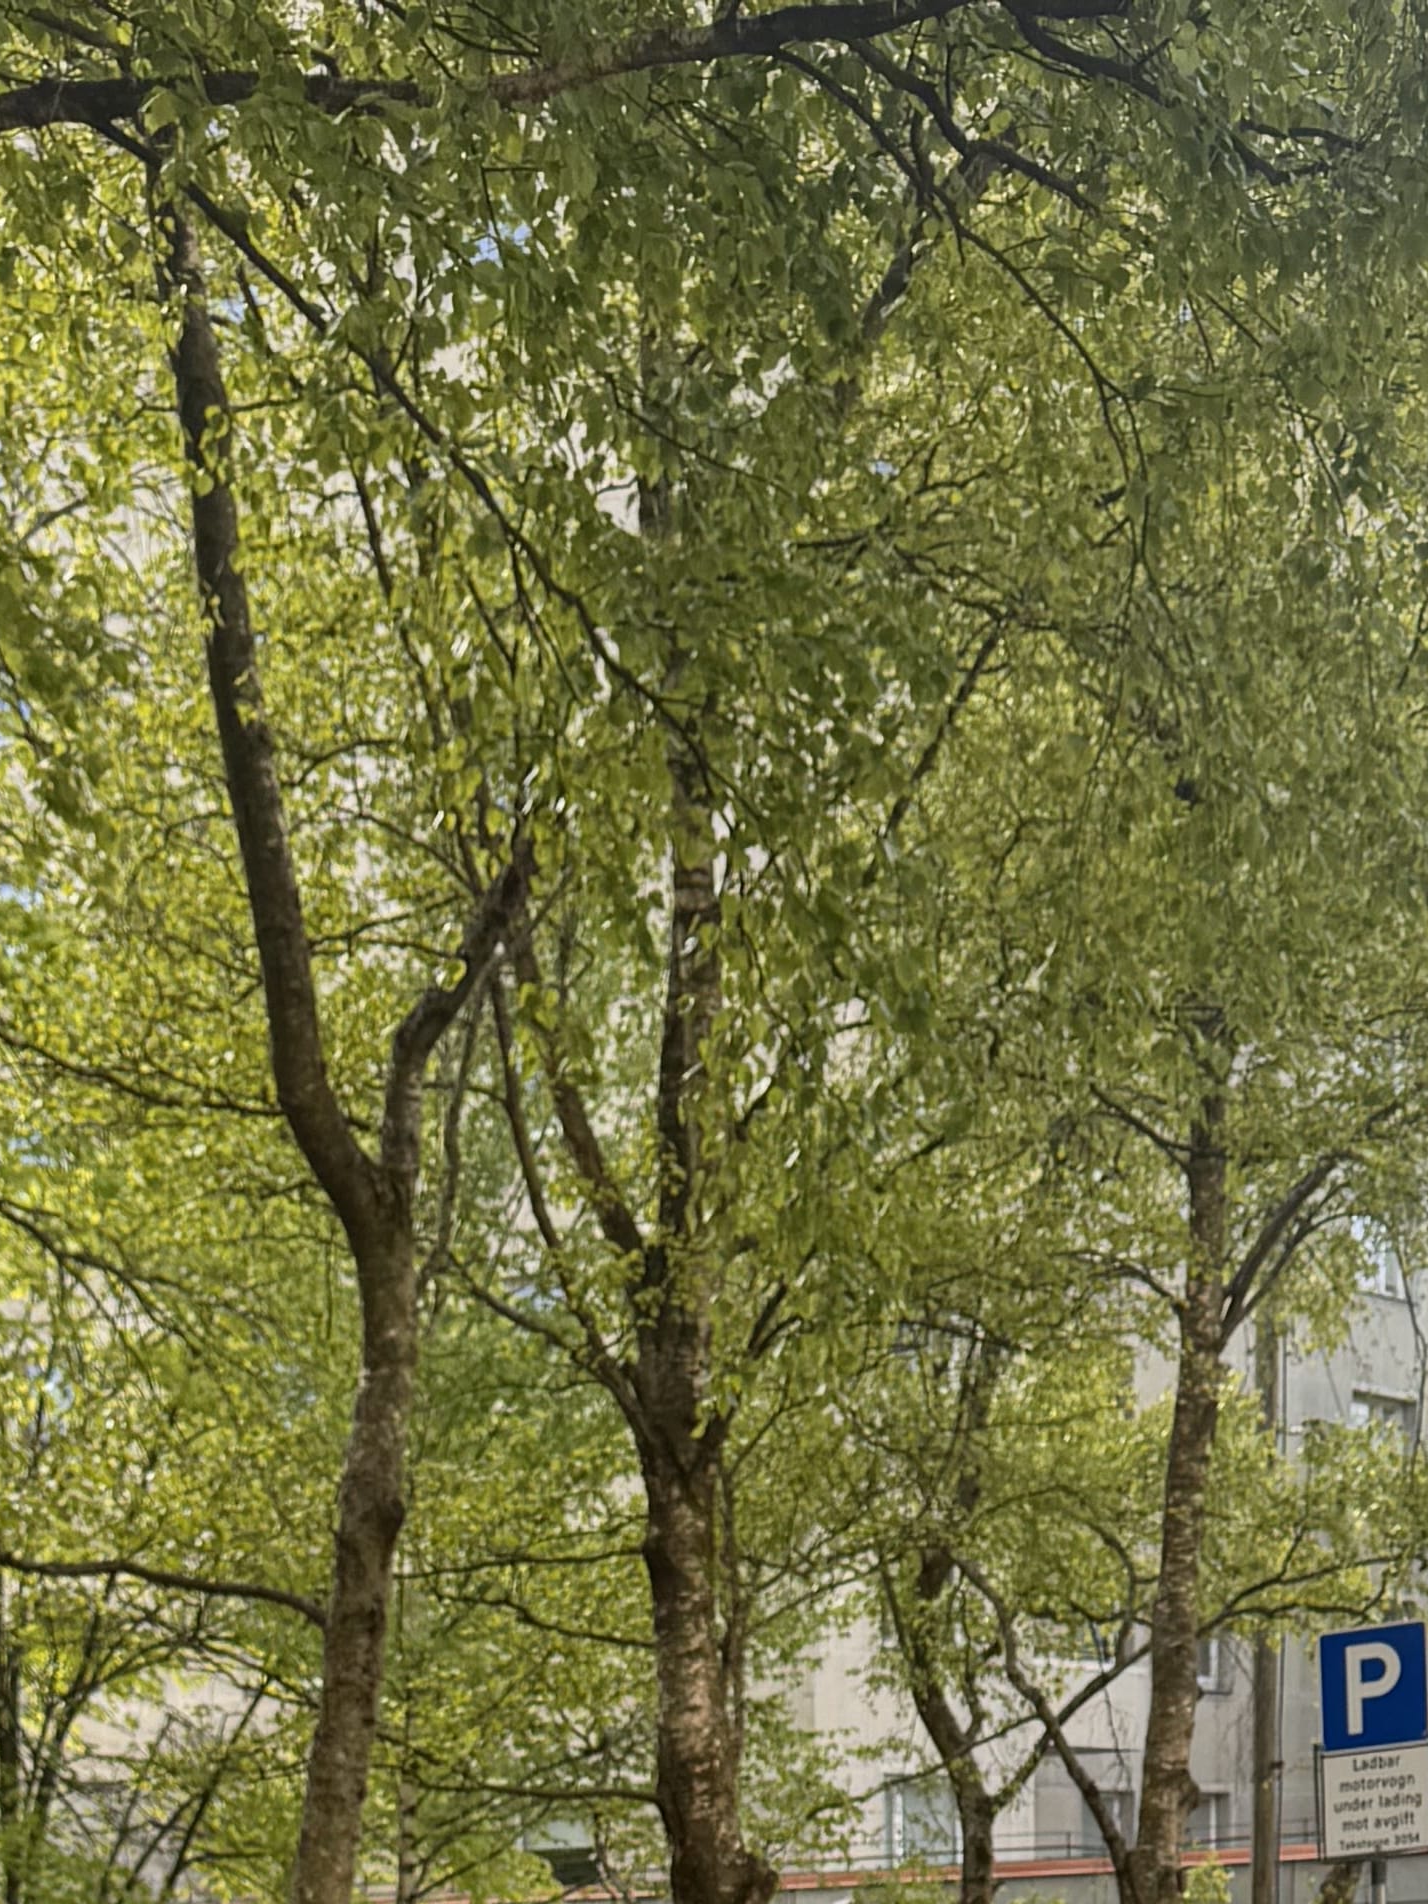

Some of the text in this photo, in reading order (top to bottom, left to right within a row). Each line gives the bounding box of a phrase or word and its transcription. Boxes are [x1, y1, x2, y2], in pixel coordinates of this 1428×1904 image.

[1344, 1641, 1402, 1736] P
[1352, 1755, 1401, 1772] Ladbar
[1339, 1774, 1415, 1793] motorvogn
[1333, 1793, 1422, 1814] under lading
[1342, 1811, 1415, 1831] mot avgift
